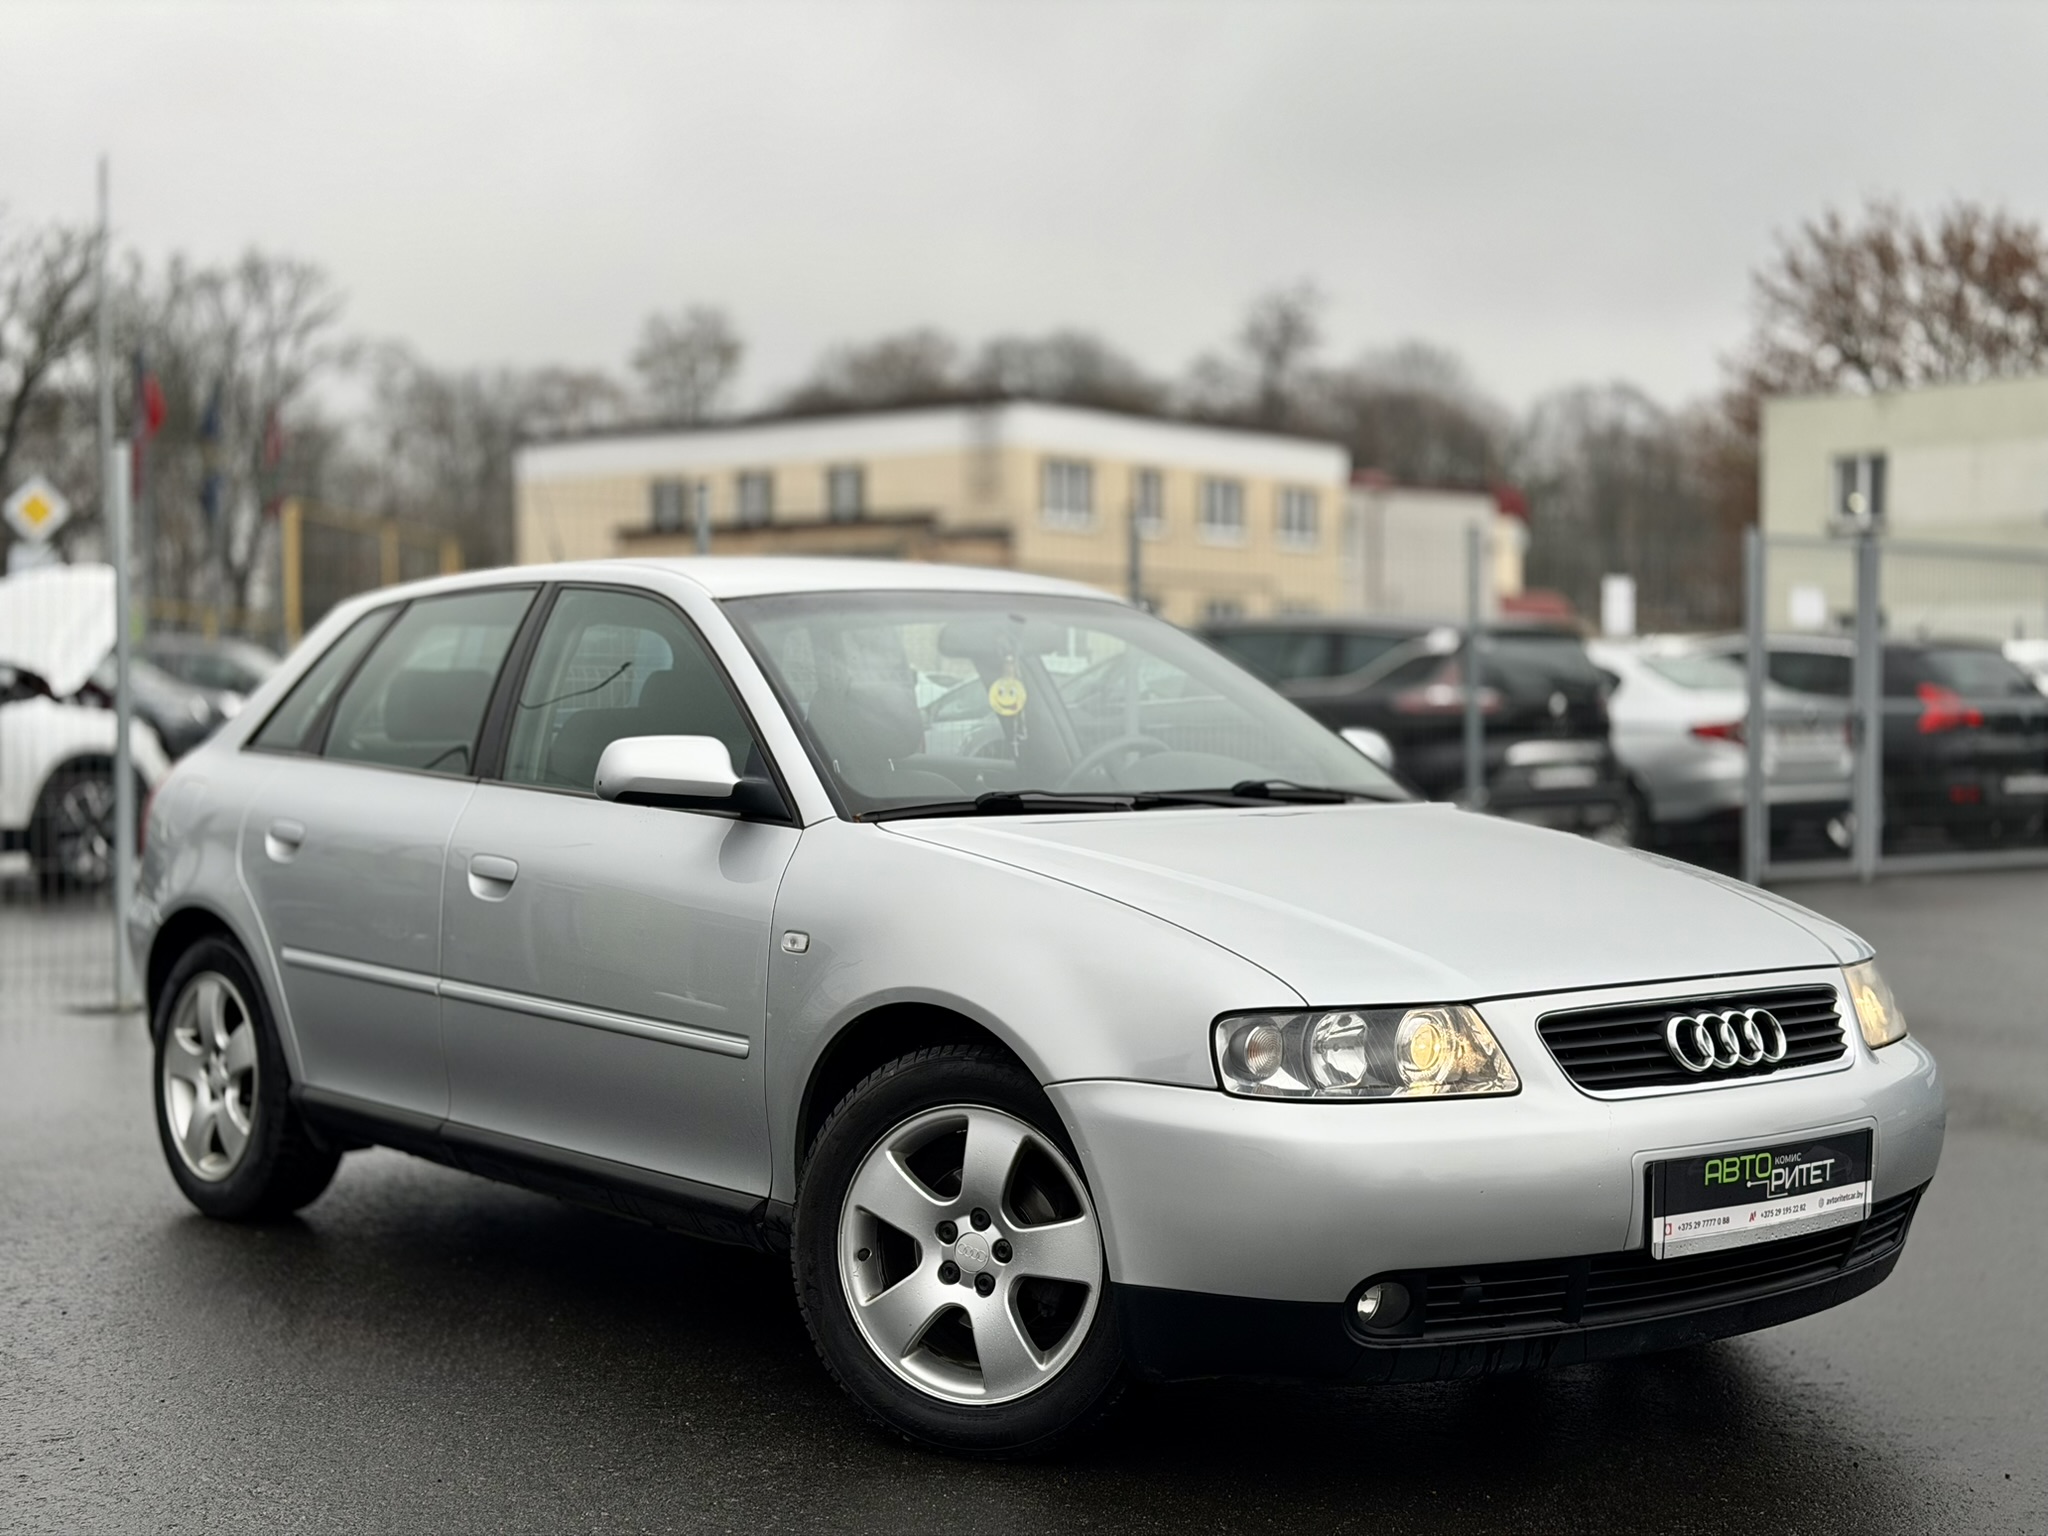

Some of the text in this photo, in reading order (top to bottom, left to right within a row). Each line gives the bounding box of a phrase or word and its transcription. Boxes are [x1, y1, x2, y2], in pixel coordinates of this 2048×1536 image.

[1774, 1152, 1802, 1165] КОМИС
[1704, 1152, 1772, 1186] АВТО
[1771, 1158, 1835, 1192] РИТЕТ
[1826, 1190, 1864, 1206] avtoritetcar.by
[1760, 1208, 1774, 1219] +375
[1775, 1207, 1782, 1216] 29
[1782, 1205, 1792, 1216] 195
[1792, 1204, 1799, 1213] 22
[1677, 1216, 1730, 1232] +375 29 7777 0 88
